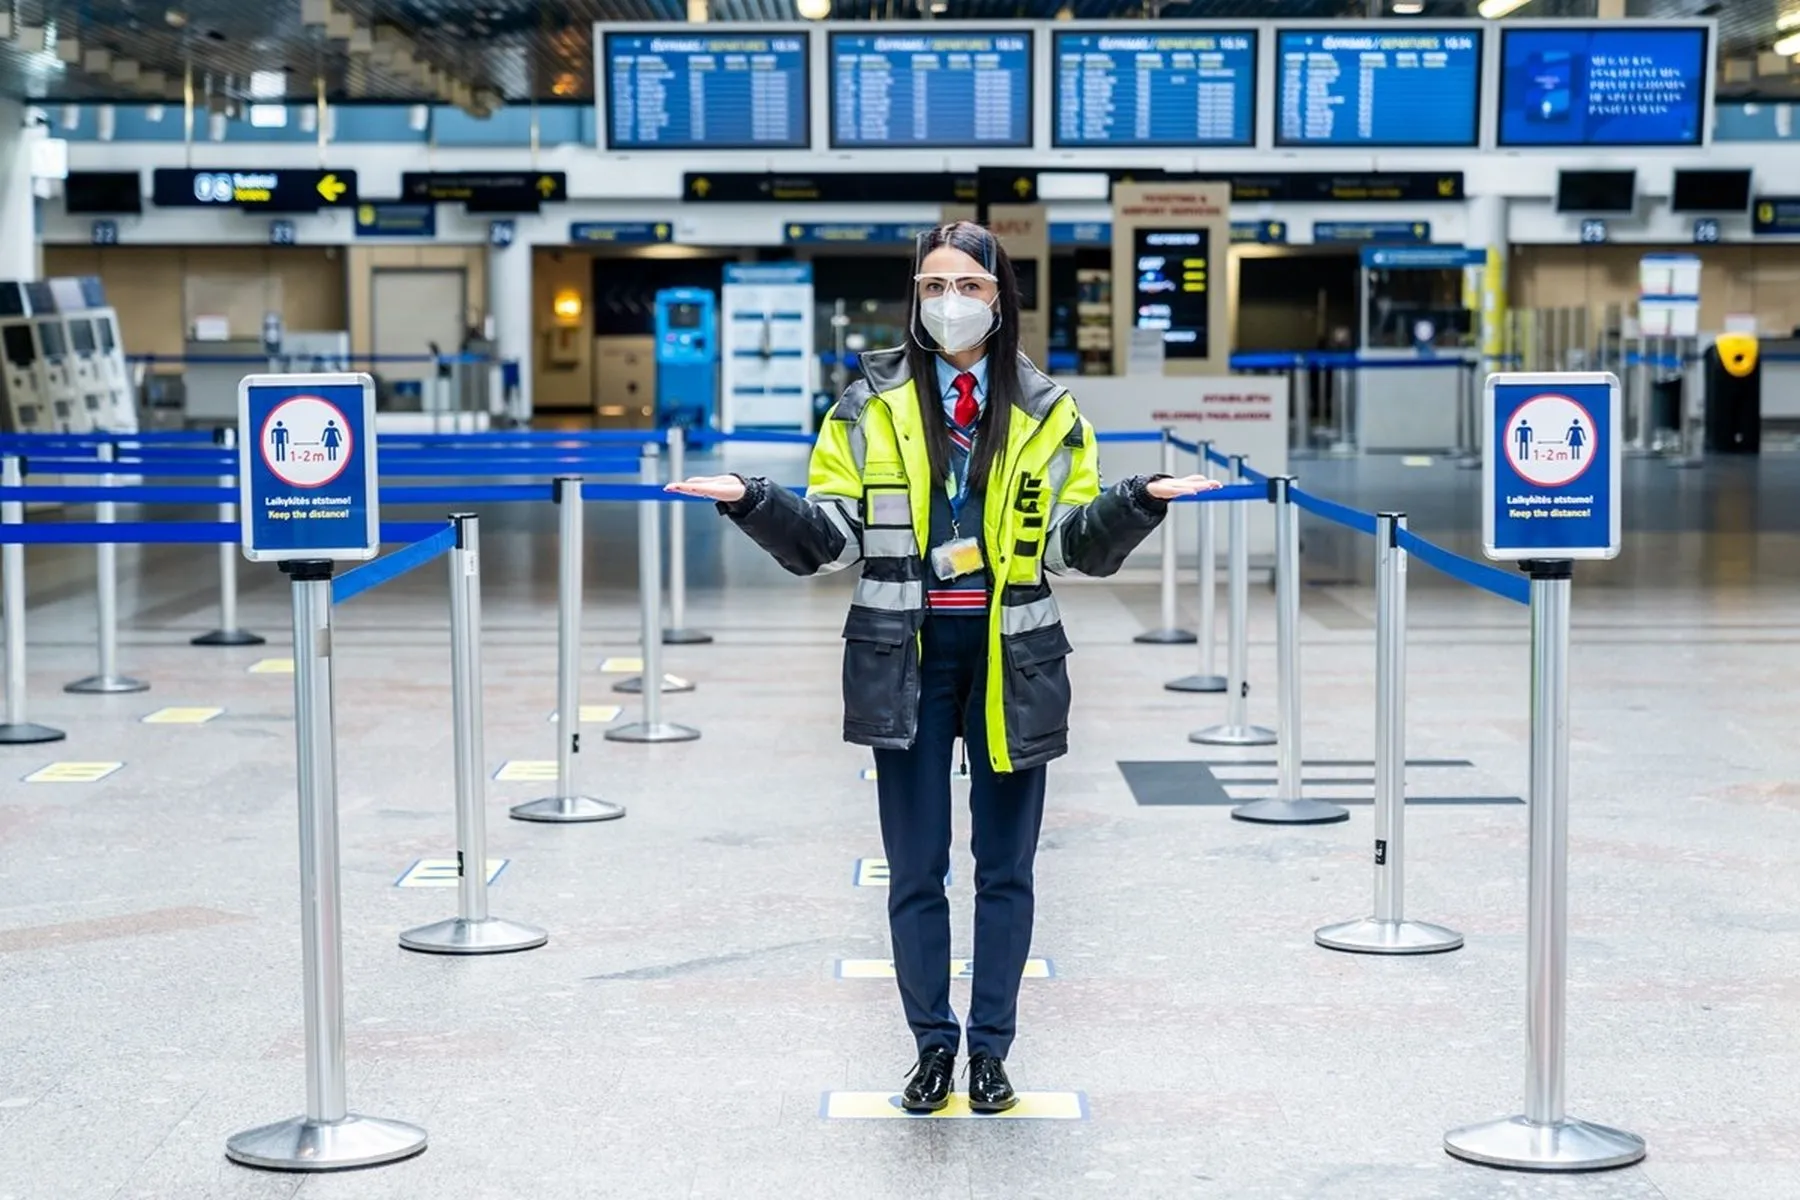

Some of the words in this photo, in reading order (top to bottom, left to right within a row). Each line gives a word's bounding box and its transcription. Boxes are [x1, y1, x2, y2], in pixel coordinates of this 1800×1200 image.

[268, 510, 290, 520] Keep
[292, 510, 307, 519] the
[308, 510, 350, 519] distance!
[1509, 509, 1532, 520] Keep
[1534, 509, 1548, 518] the
[1550, 508, 1591, 518] distance!
